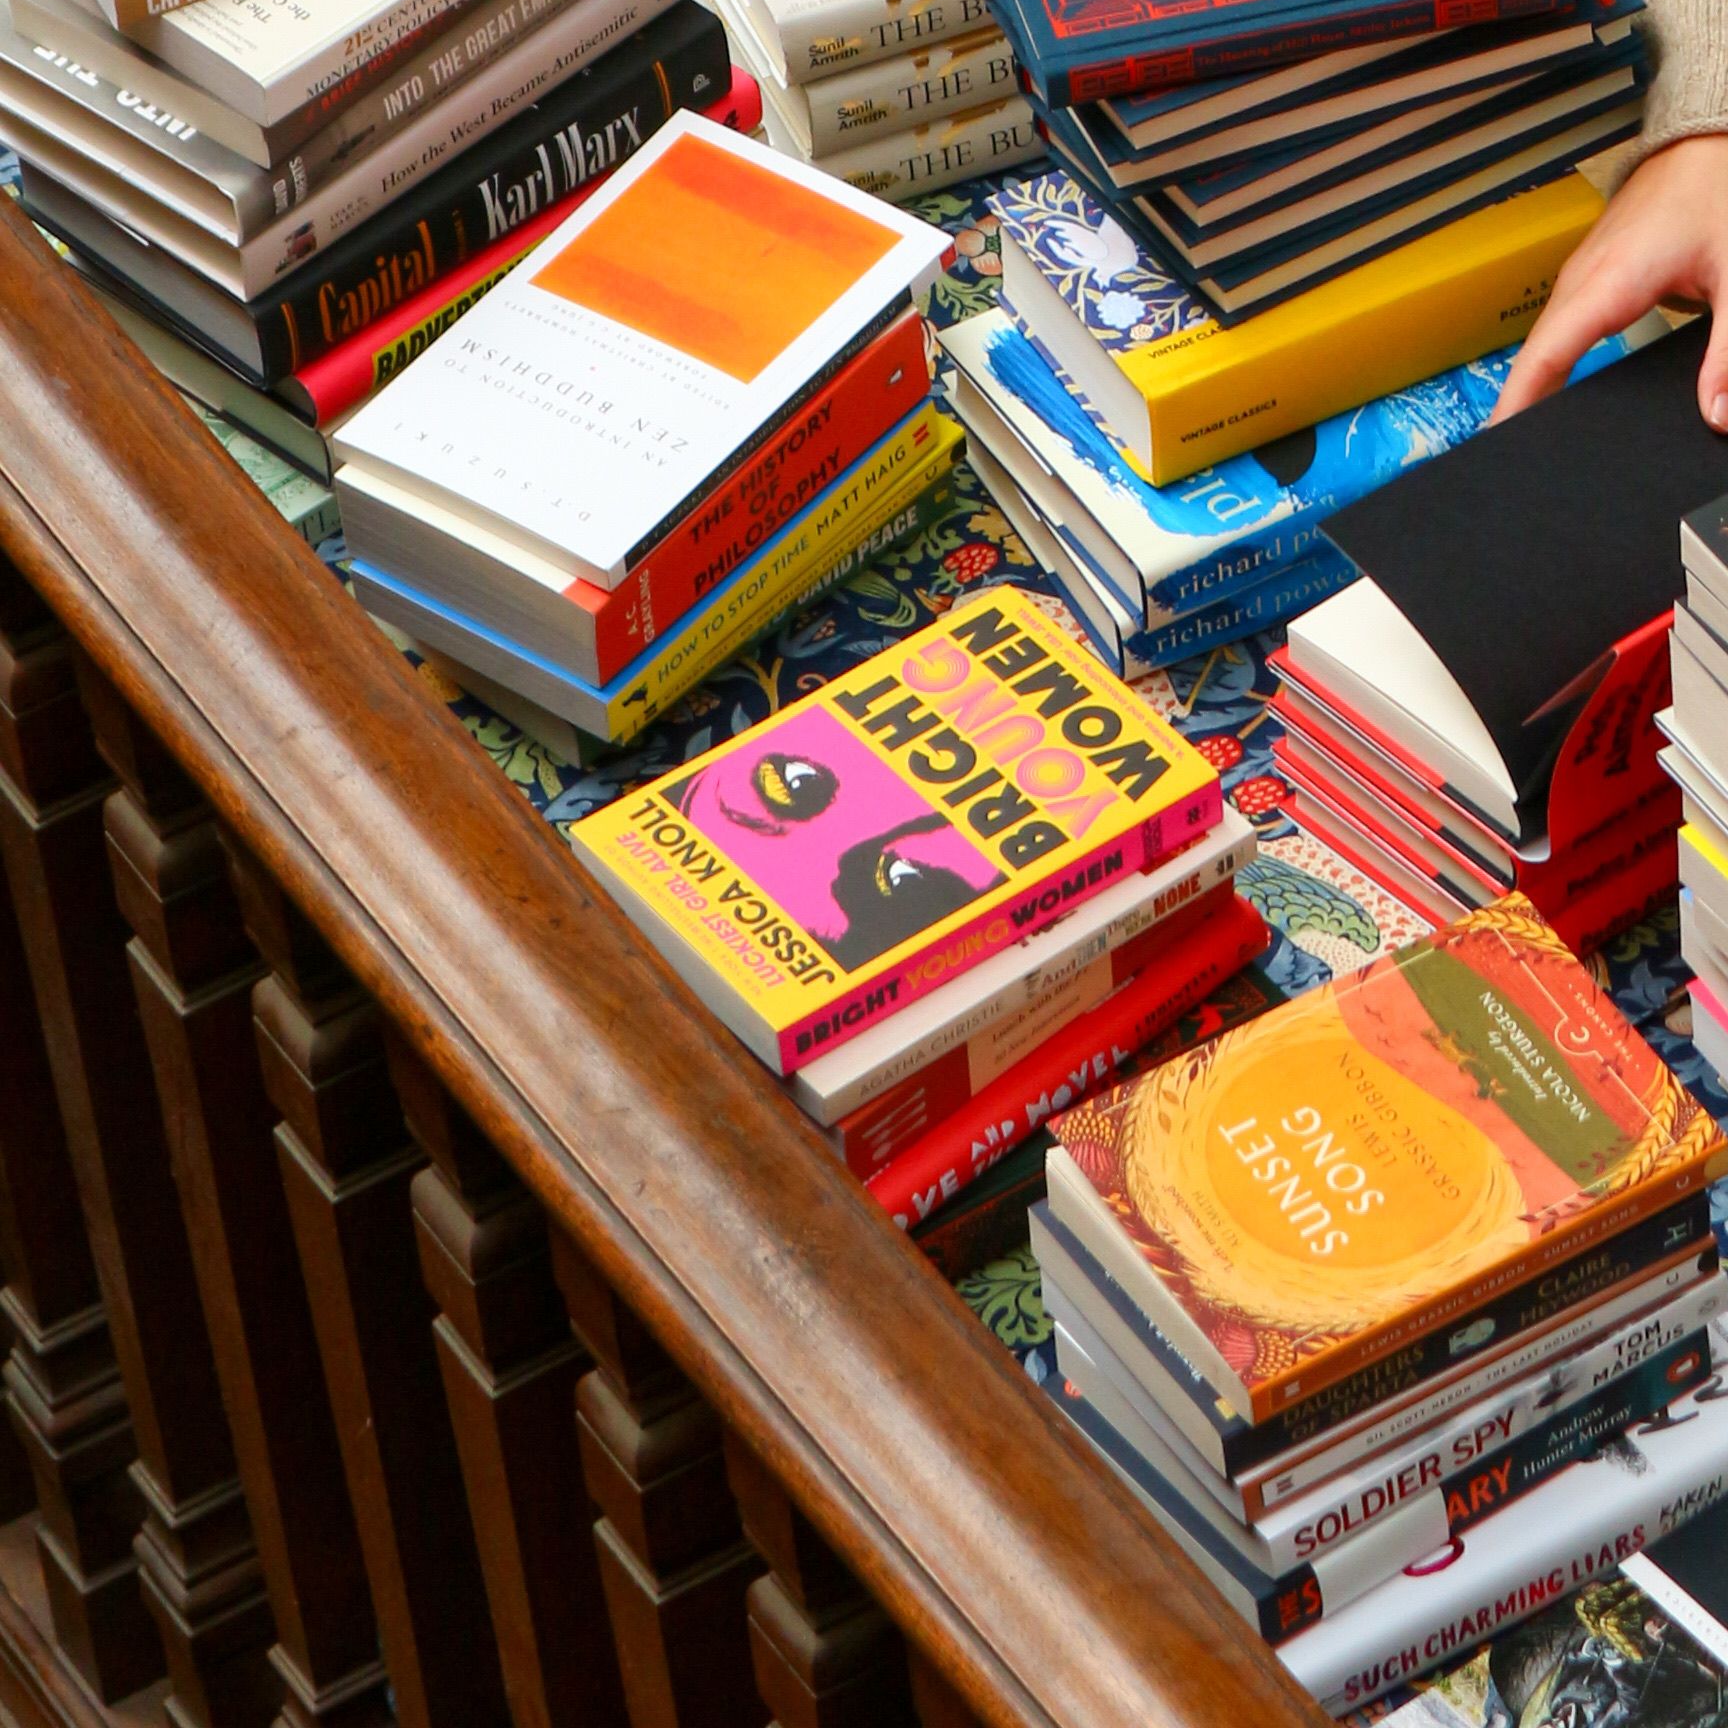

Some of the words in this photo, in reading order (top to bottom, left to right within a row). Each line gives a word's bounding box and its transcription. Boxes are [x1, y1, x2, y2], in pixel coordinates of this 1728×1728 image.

[380, 160, 417, 194] How
[423, 136, 447, 168] the
[449, 110, 489, 147] West
[490, 74, 548, 117] Became
[552, 6, 639, 76] Antisemitic
[384, 76, 424, 120] INTO
[429, 50, 464, 86] THE
[466, 12, 518, 60] GREAT
[318, 220, 436, 331] Capital
[478, 144, 554, 240] Karl
[554, 107, 642, 191] Marx
[688, 496, 733, 544] THE
[740, 399, 834, 493] HISTORY
[694, 447, 842, 596] PHILOSOPHY
[750, 476, 779, 516] OF
[659, 636, 699, 683] HOW
[702, 613, 724, 640] TO
[728, 571, 768, 616] STOP
[773, 534, 808, 576] TIME
[817, 488, 860, 535] MATT
[866, 446, 906, 490] HAIG
[832, 675, 1068, 870] BRIGHT
[902, 638, 1119, 841] YOUNG
[950, 607, 1172, 802] WOMEN
[630, 798, 722, 881] KNOLL
[719, 882, 835, 987] JESSICA
[795, 982, 899, 1053] BRIGHT
[905, 922, 1010, 990] YOUNG
[1012, 850, 1123, 931] WOMEN
[1479, 992, 1547, 1068] STURGEON
[1544, 1066, 1591, 1123] NICOLA
[1218, 1117, 1348, 1255] SUNSET
[1282, 1107, 1385, 1215] SONG
[1593, 1324, 1685, 1386] MARCUS
[1613, 1319, 1661, 1355] TOM
[1295, 1456, 1441, 1558] SOLDIER
[1452, 1411, 1519, 1467] SPY
[1343, 1645, 1419, 1702] SUCH
[1424, 1568, 1564, 1659] CHARMING
[1572, 1526, 1647, 1583] LIARS
